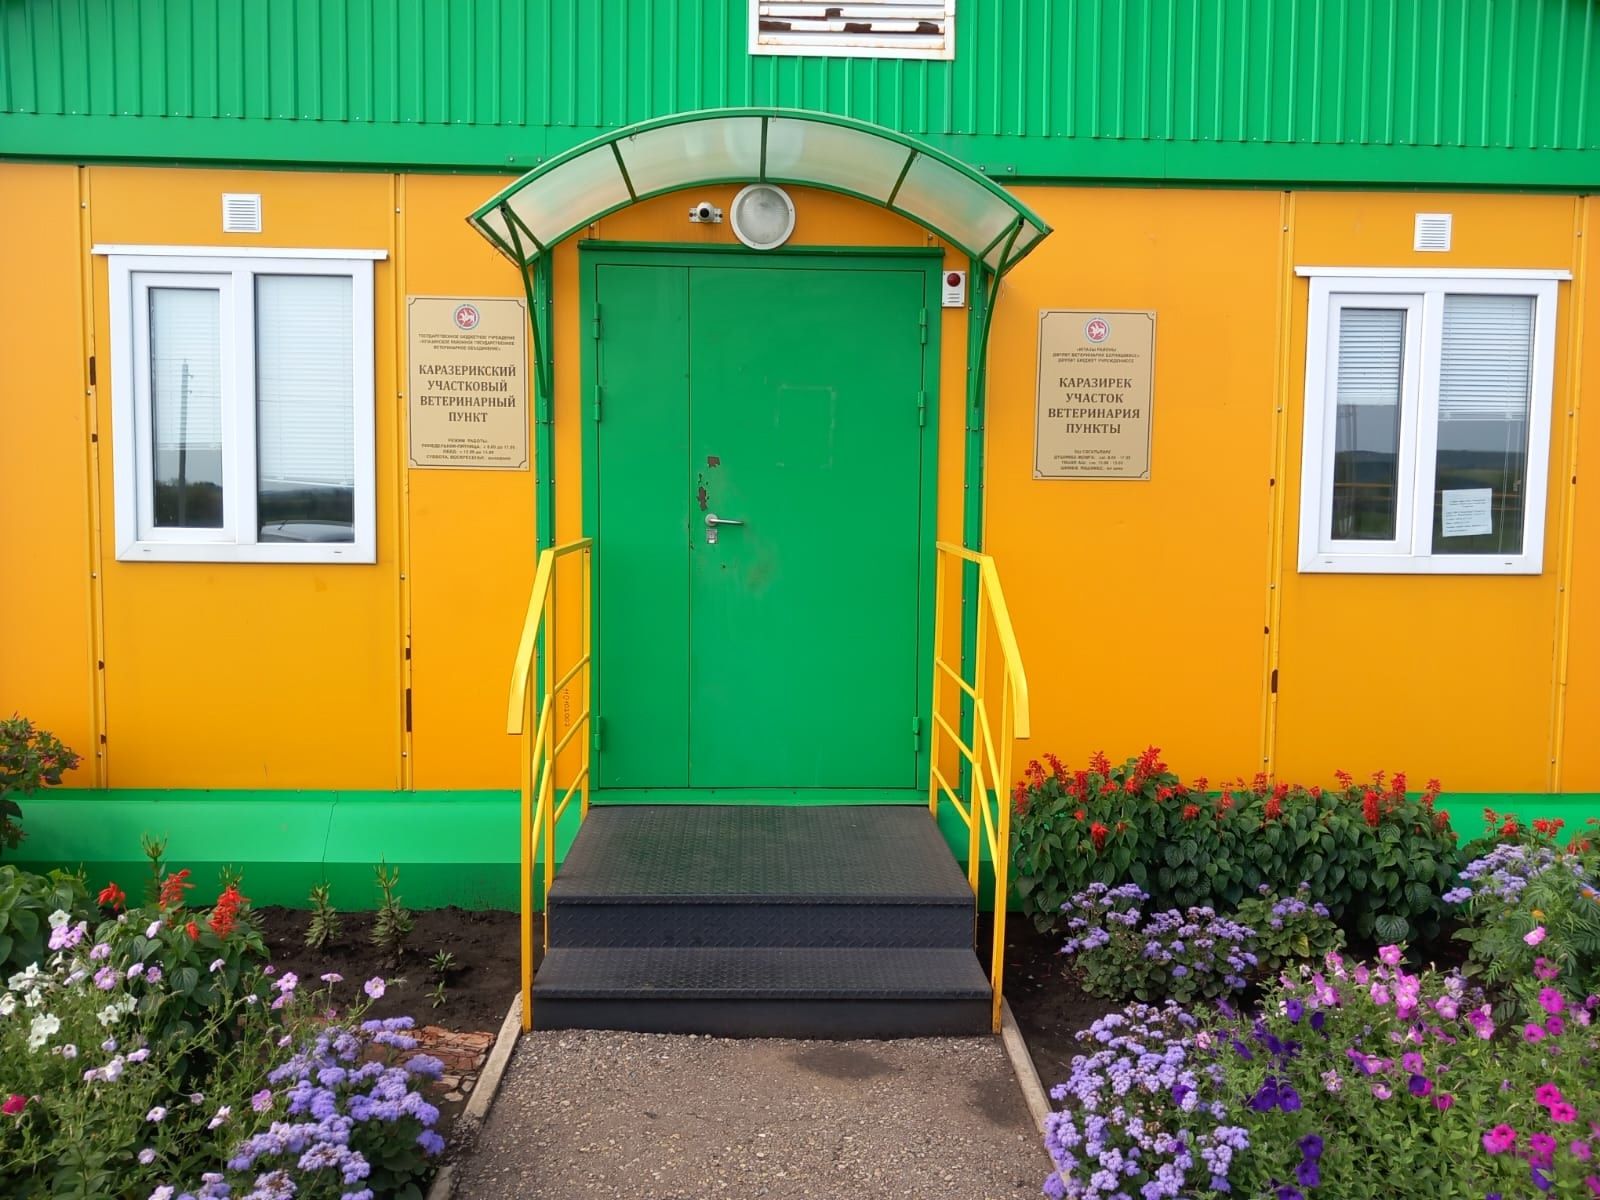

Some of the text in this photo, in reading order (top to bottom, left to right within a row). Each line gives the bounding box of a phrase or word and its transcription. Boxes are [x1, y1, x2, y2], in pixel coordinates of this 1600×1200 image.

[419, 364, 516, 377] КАРАЗЕРИКСКИЙ
[427, 379, 508, 392] УЧАСТКОВЫЙ
[1059, 377, 1133, 388] КАРАЗИРЕК
[420, 395, 516, 408] ВЕТЕРИНАРНЫЙ
[1065, 393, 1124, 404] УЧАСТОК
[448, 411, 489, 423] ПУНКТ
[1048, 408, 1140, 419] ВЕТЕРИНАРИЯ
[1065, 423, 1121, 434] ПУНКТЫ
